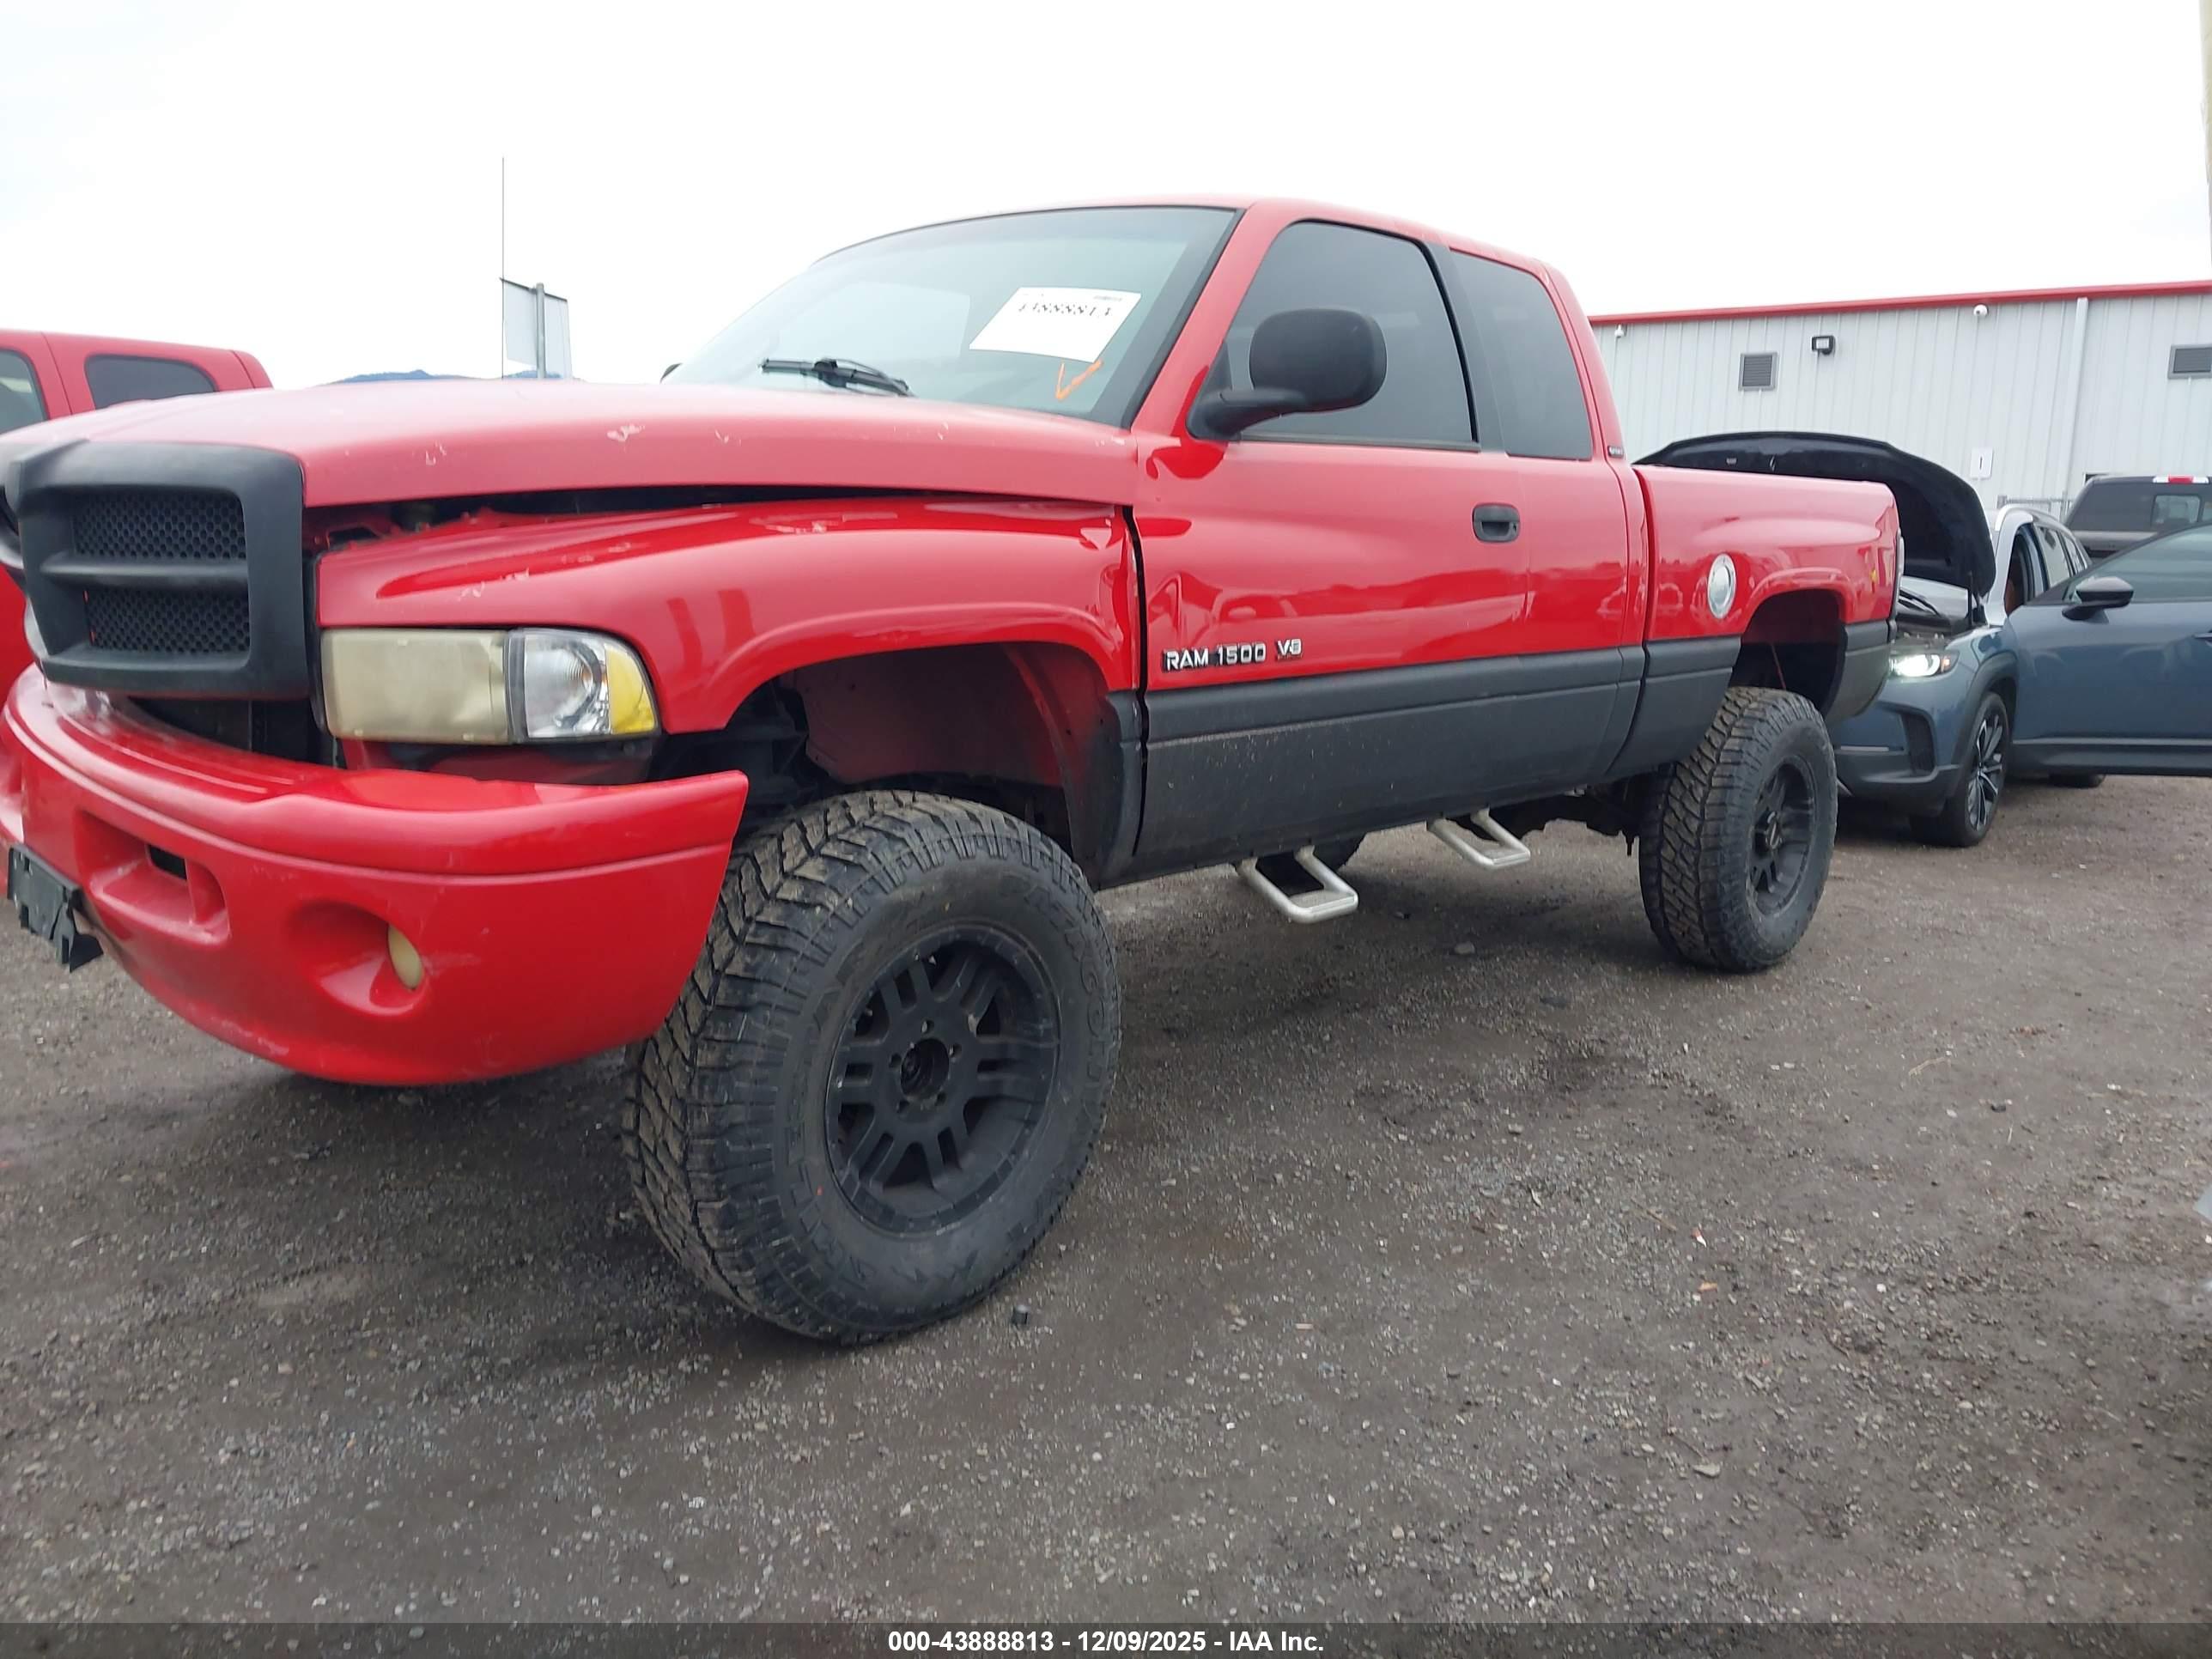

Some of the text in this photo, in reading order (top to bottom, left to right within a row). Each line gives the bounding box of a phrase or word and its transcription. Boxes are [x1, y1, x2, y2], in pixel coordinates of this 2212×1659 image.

[1163, 638, 1304, 672] RAM 1500 V8
